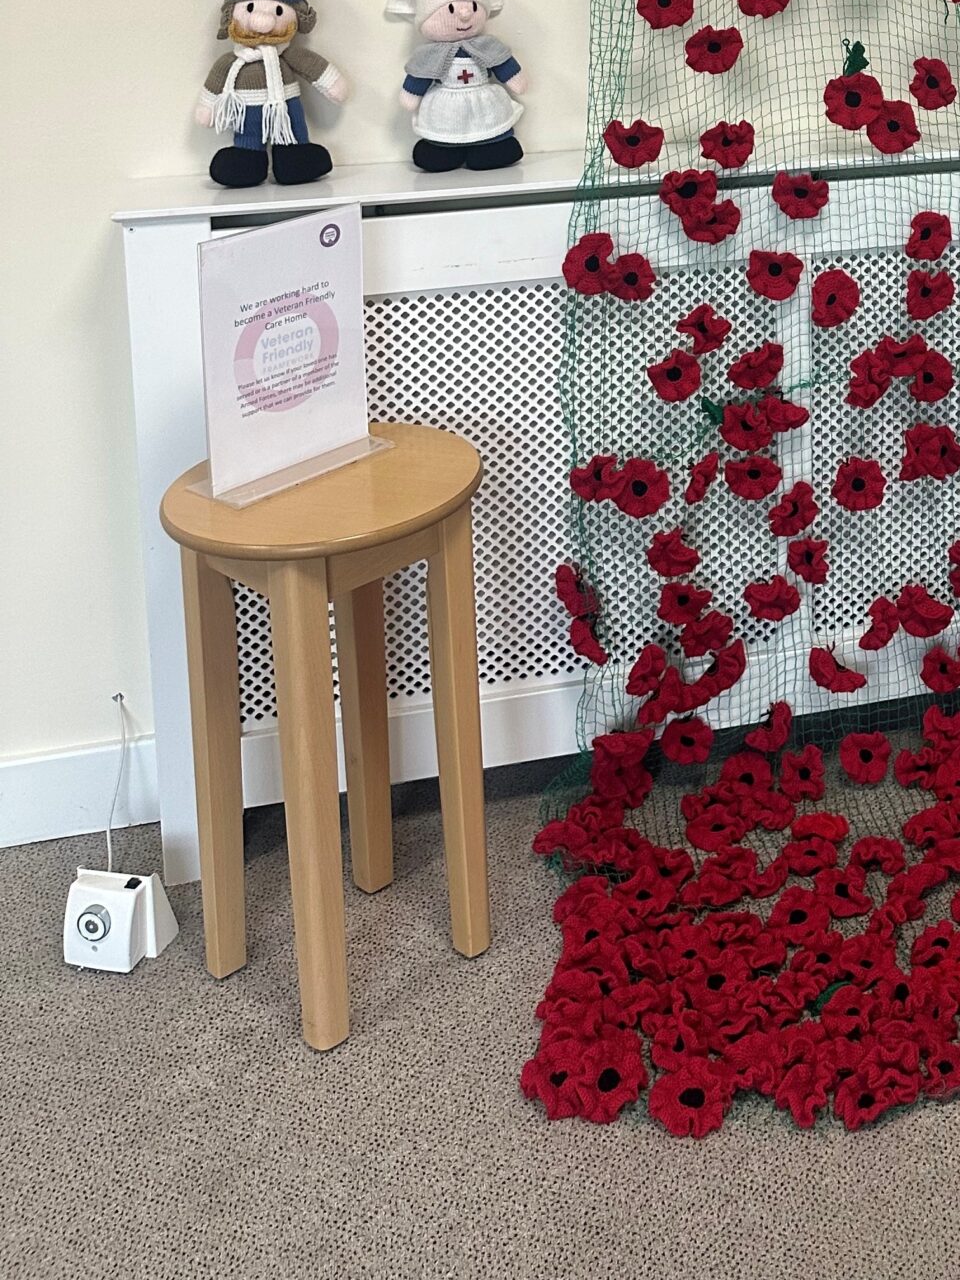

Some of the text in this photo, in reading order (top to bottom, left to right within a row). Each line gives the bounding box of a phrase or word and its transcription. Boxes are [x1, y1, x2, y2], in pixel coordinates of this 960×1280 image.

[240, 304, 252, 312] We
[255, 300, 267, 308] are
[270, 289, 300, 303] working
[302, 282, 319, 293] hard
[234, 312, 265, 327] become
[274, 301, 303, 315] Veteran
[305, 291, 335, 305] Friendly
[265, 312, 307, 330] Care Home
[261, 327, 312, 349] Veteran
[263, 339, 313, 363] Friendly
[238, 381, 254, 390] Please
[291, 365, 302, 373] your
[272, 378, 290, 389] partner
[303, 367, 323, 377] member
[241, 399, 257, 408] Armed
[278, 387, 291, 395] there
[293, 389, 312, 399] provide
